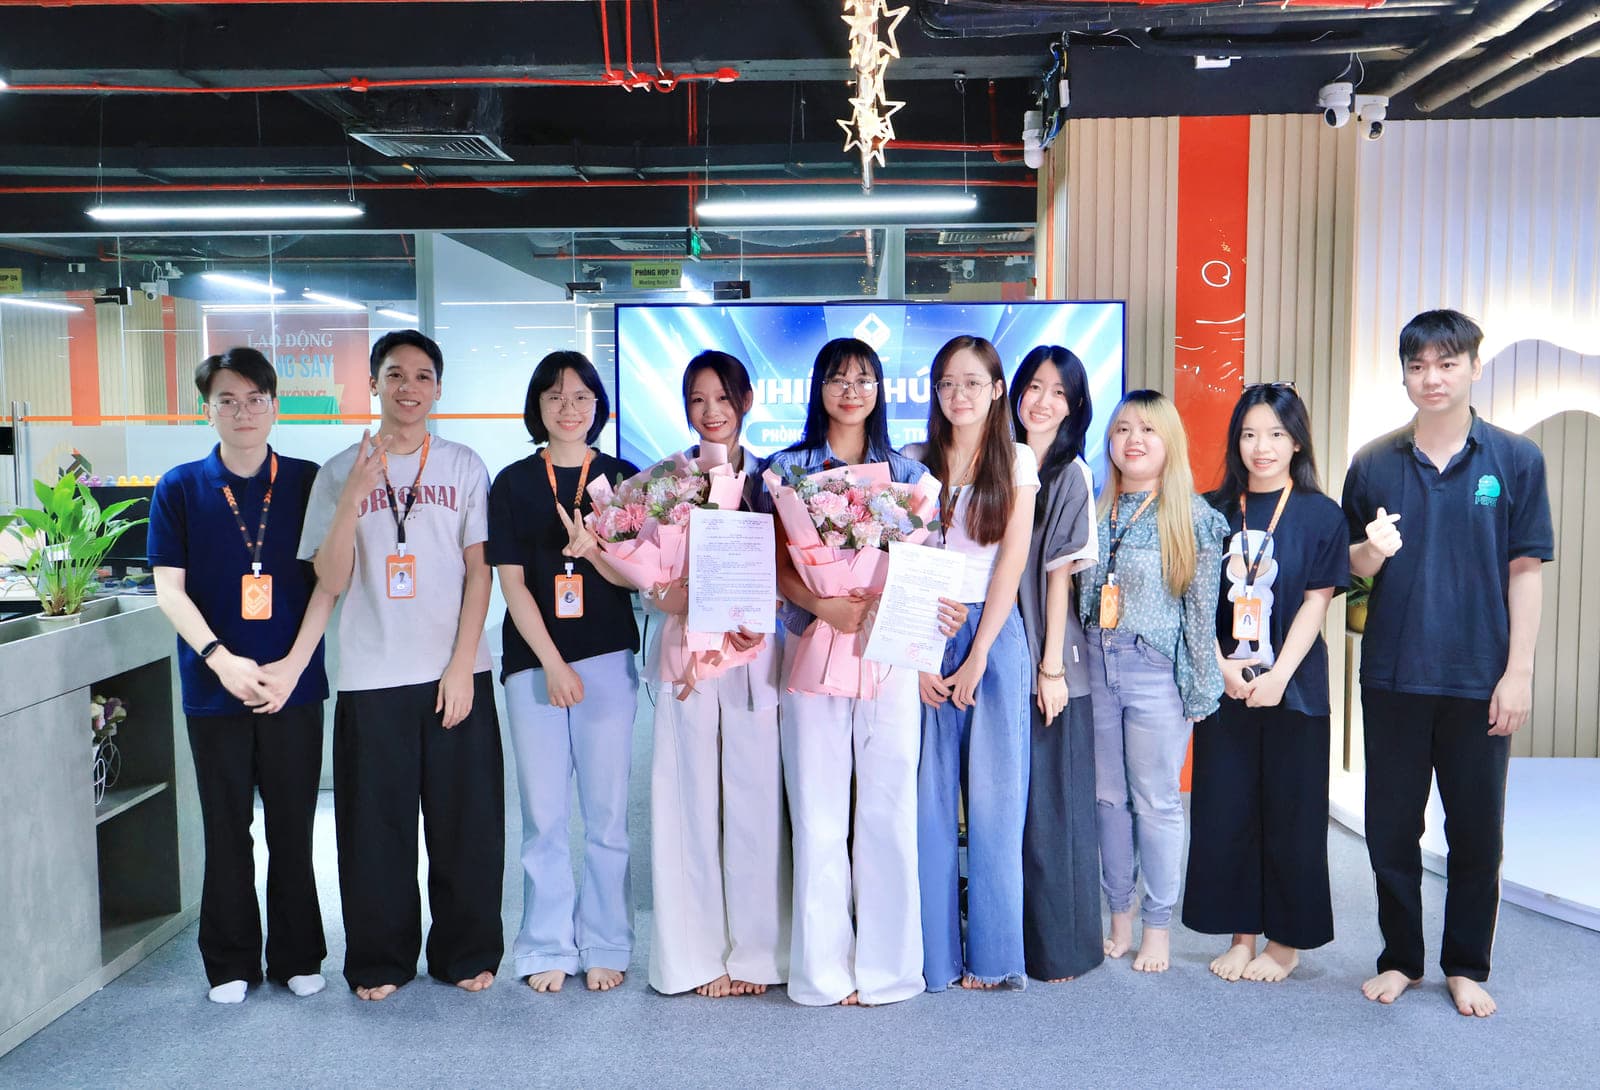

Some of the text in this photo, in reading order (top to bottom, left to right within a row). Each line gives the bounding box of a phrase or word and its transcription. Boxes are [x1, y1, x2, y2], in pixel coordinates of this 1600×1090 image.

[247, 329, 333, 351] LAO ĐỘNG
[300, 353, 334, 378] SAY
[752, 367, 814, 404] NHI
[357, 485, 458, 517] RGINAL
